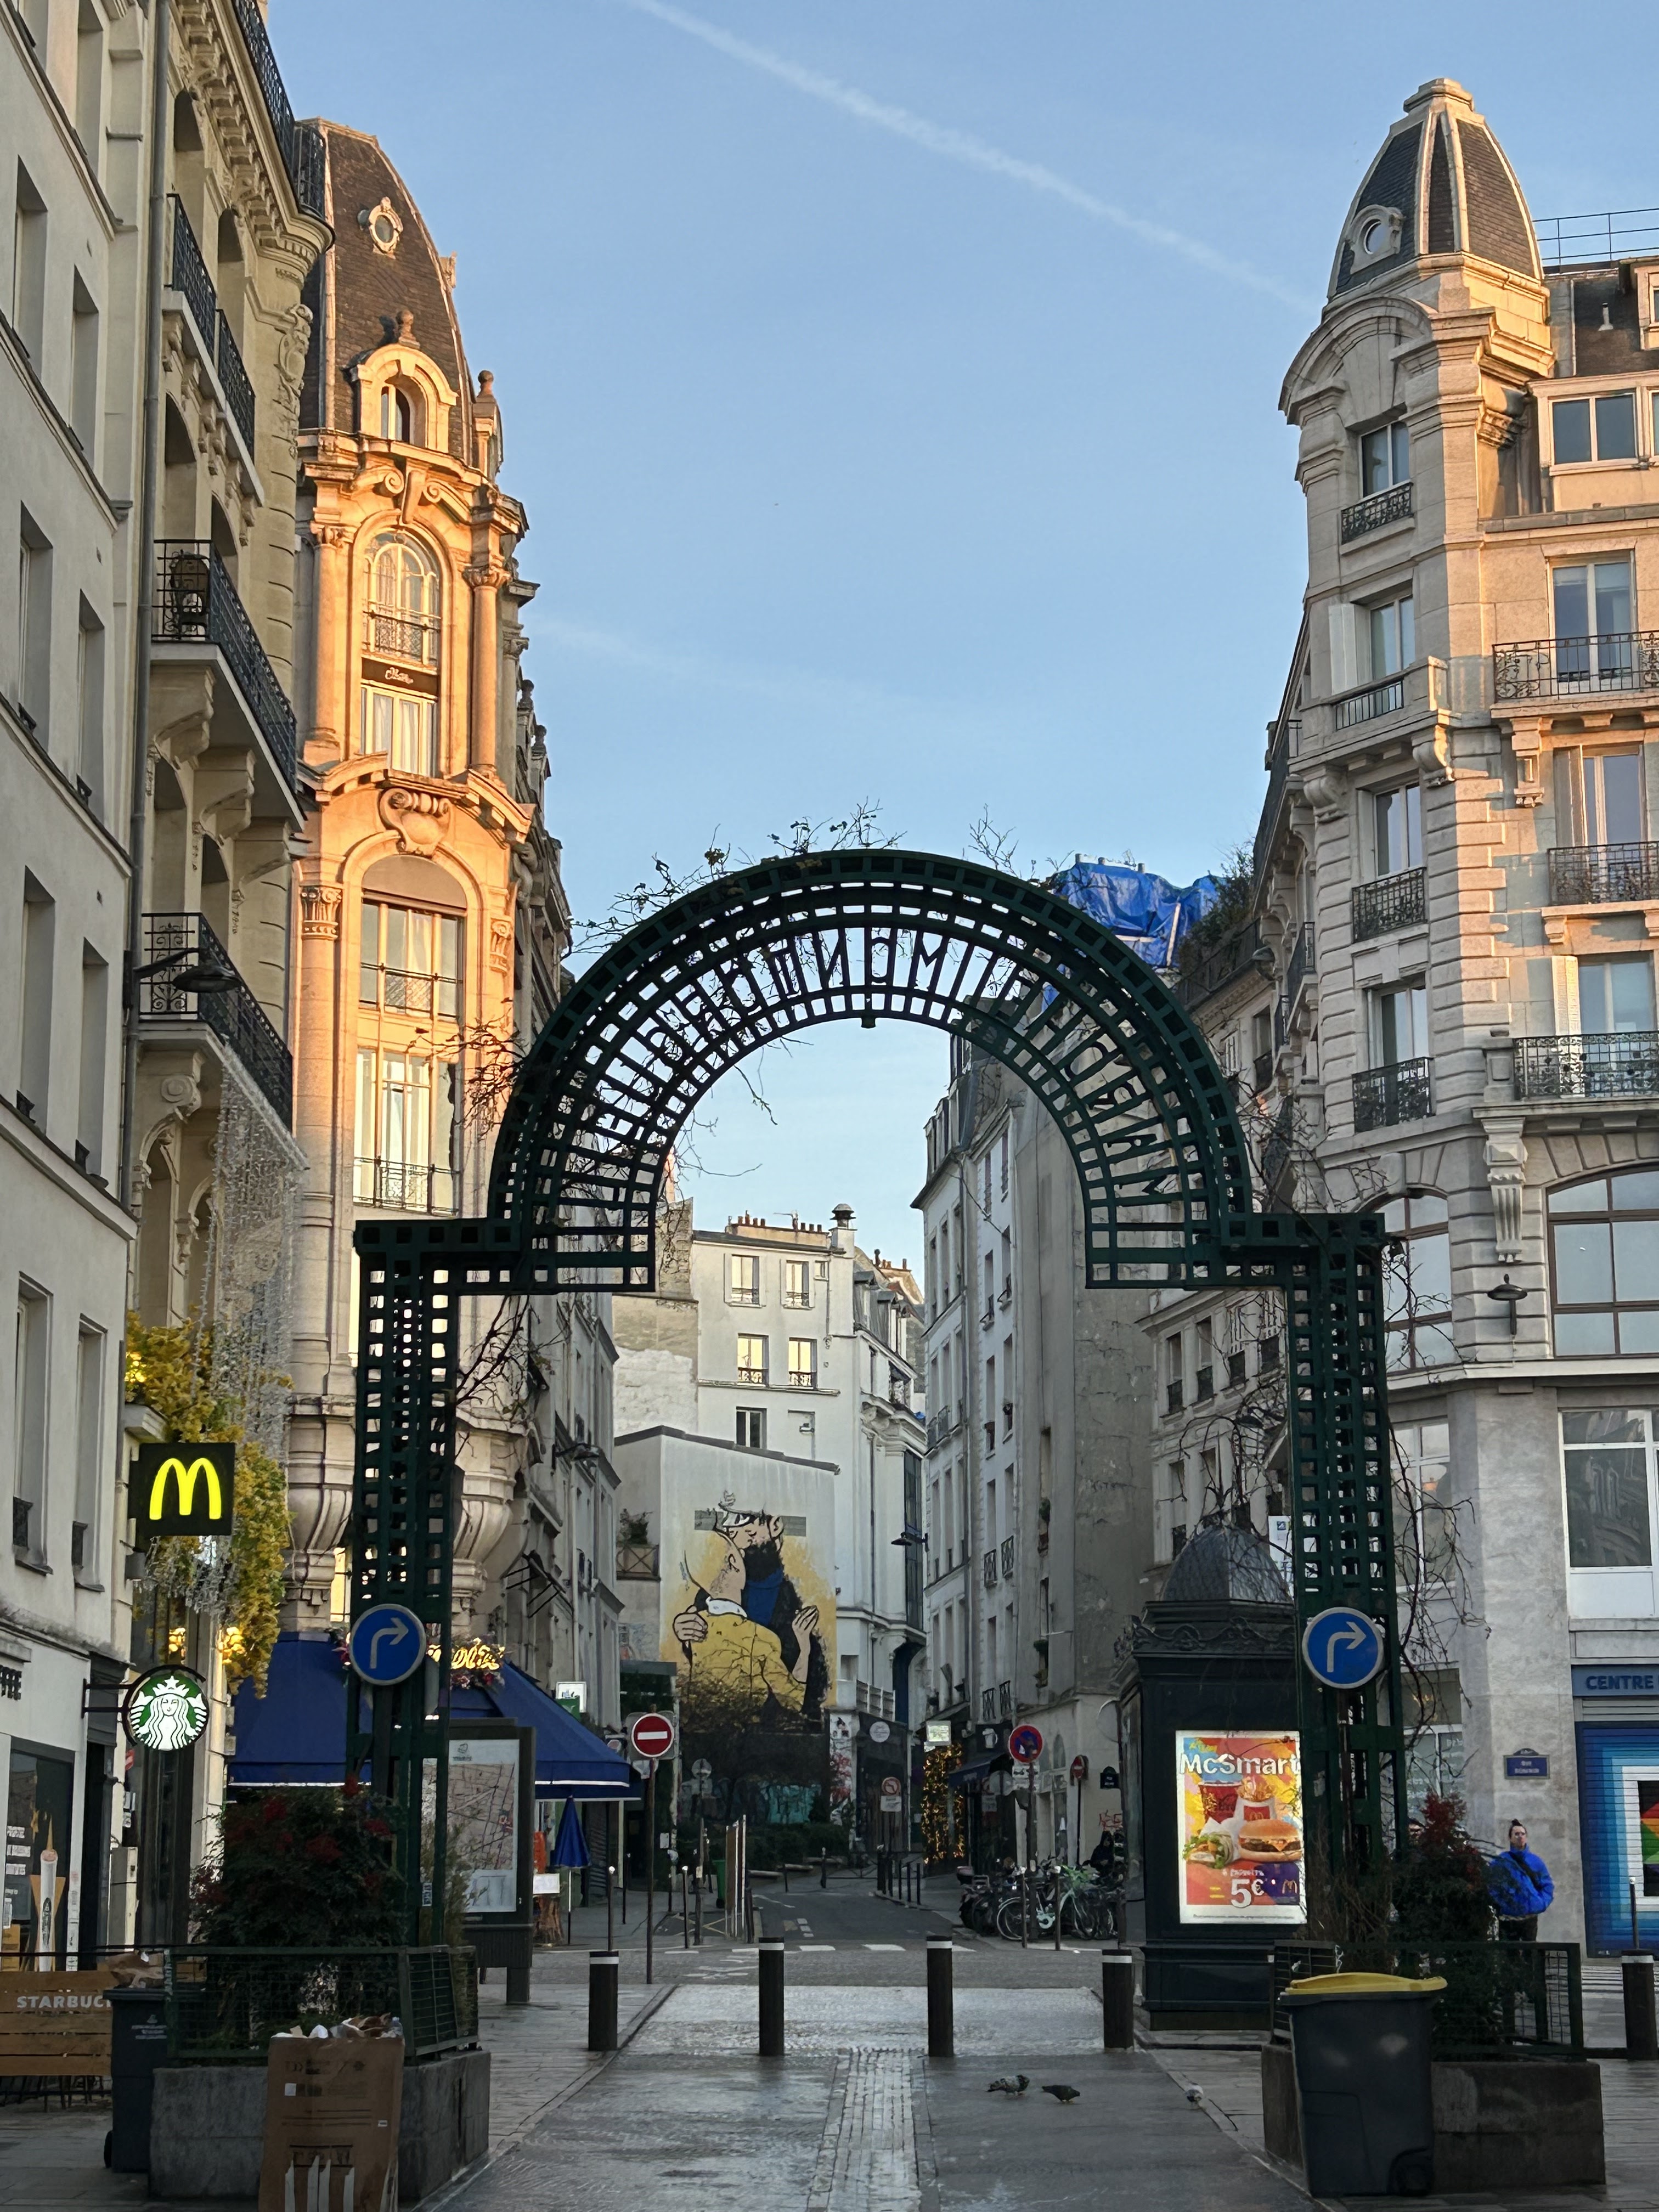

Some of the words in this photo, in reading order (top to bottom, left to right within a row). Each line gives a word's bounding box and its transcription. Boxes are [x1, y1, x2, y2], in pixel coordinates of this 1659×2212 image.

[149, 1457, 222, 1520] M
[1585, 1675, 1654, 1690] CENTRE
[1180, 1753, 1300, 1774] McSmart
[17, 1995, 112, 2008] STARBUC
